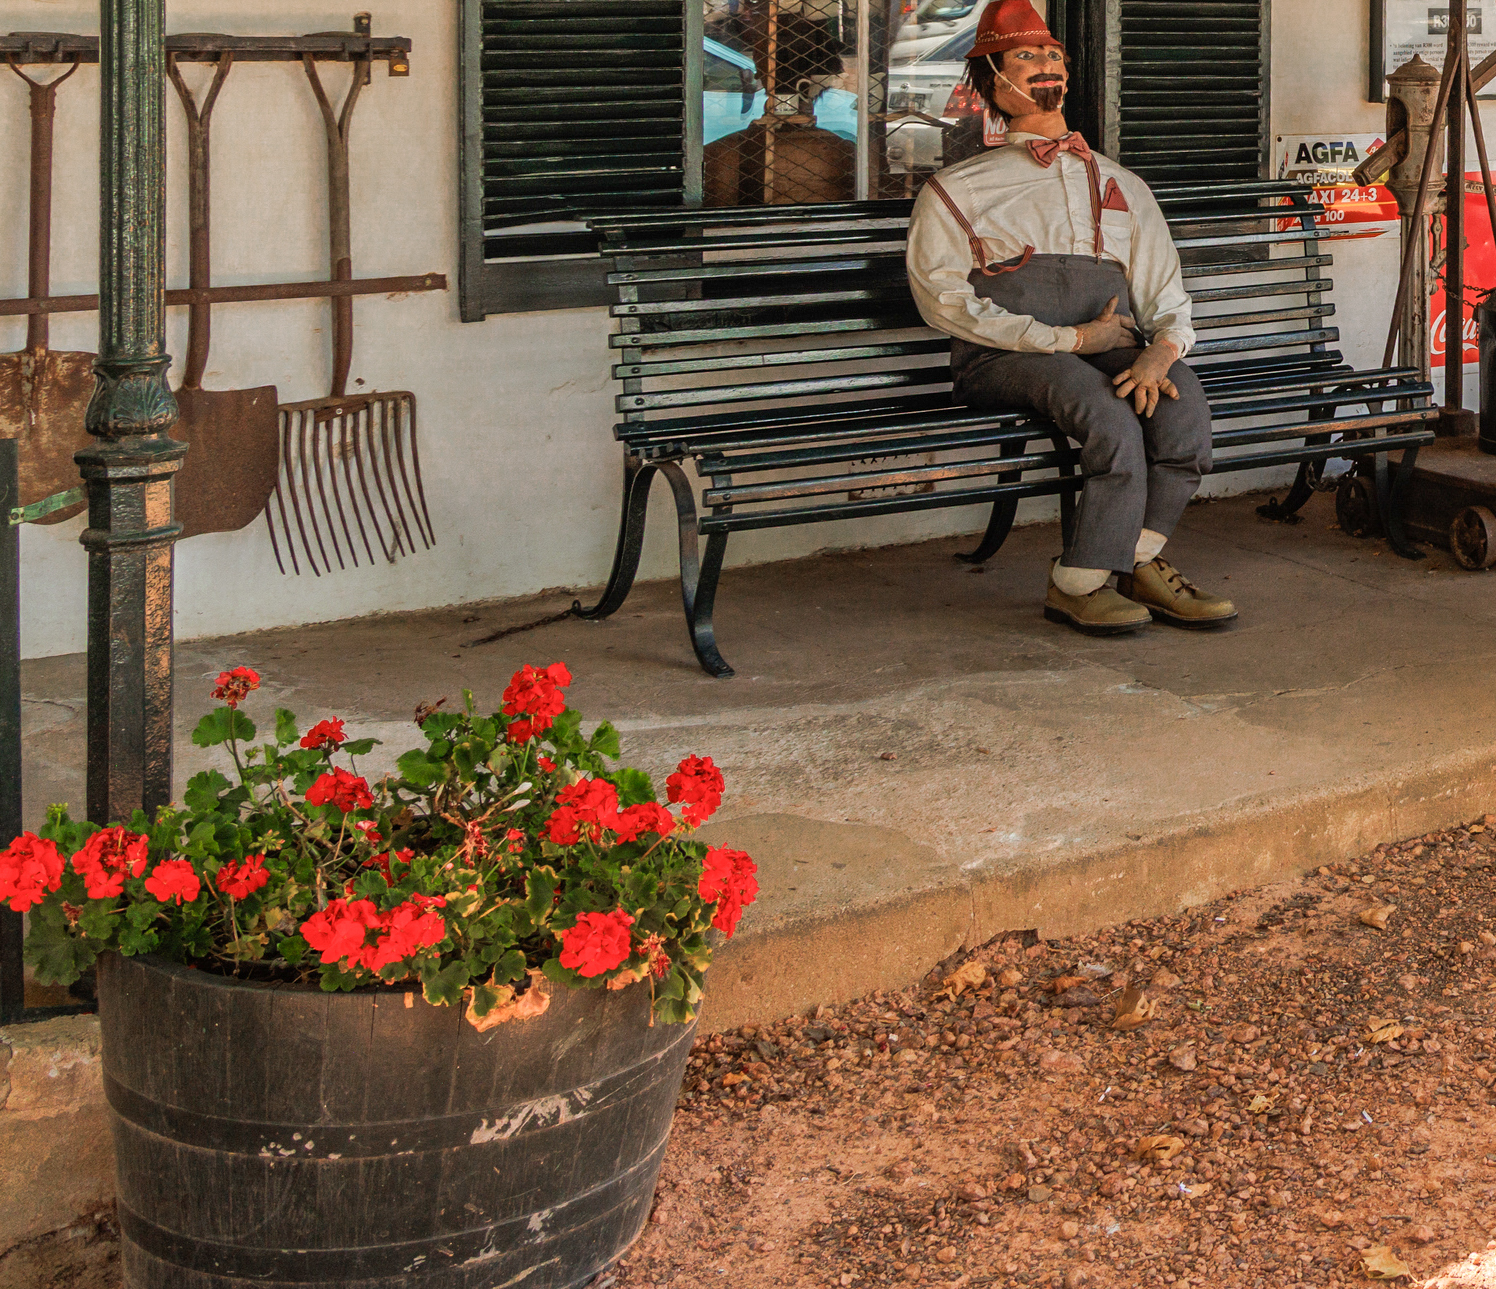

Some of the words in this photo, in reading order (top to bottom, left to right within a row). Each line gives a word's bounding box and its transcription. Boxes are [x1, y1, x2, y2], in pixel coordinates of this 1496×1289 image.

[1295, 141, 1359, 165] AGFA
[1341, 187, 1377, 203] 24+3
[1324, 210, 1344, 222] 100
